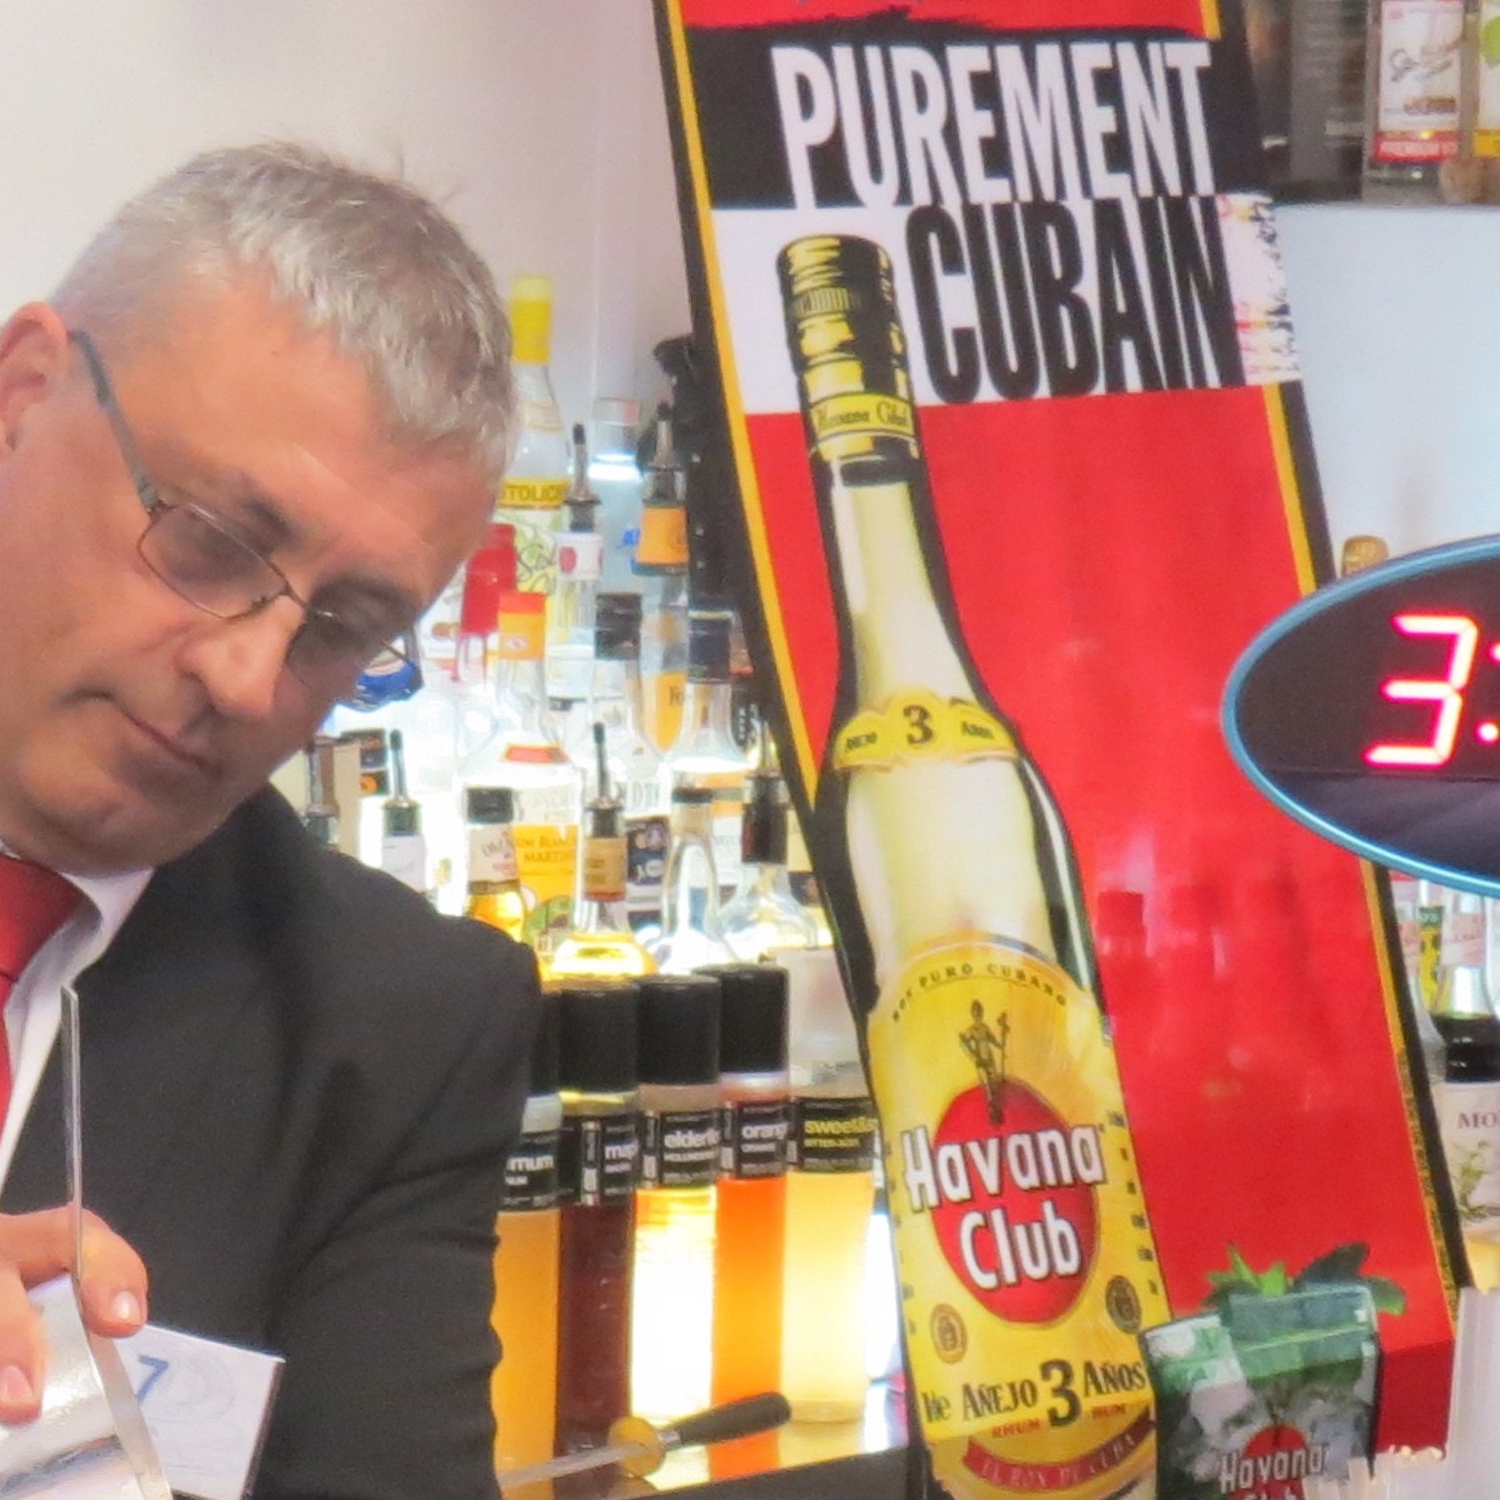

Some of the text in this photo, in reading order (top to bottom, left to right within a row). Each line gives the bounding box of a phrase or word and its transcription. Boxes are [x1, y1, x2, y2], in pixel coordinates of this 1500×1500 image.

[770, 38, 1216, 207] PUREMENT
[906, 193, 1246, 403] CUBAIN
[903, 704, 934, 745] 3
[901, 1125, 1108, 1212] Havana
[959, 1199, 1082, 1290] Club
[135, 1354, 169, 1405] 7
[962, 1378, 1039, 1422] AÑEJO
[1040, 1358, 1083, 1428] 3
[1082, 1360, 1147, 1398] AÑOS
[1219, 1446, 1324, 1494] Havana
